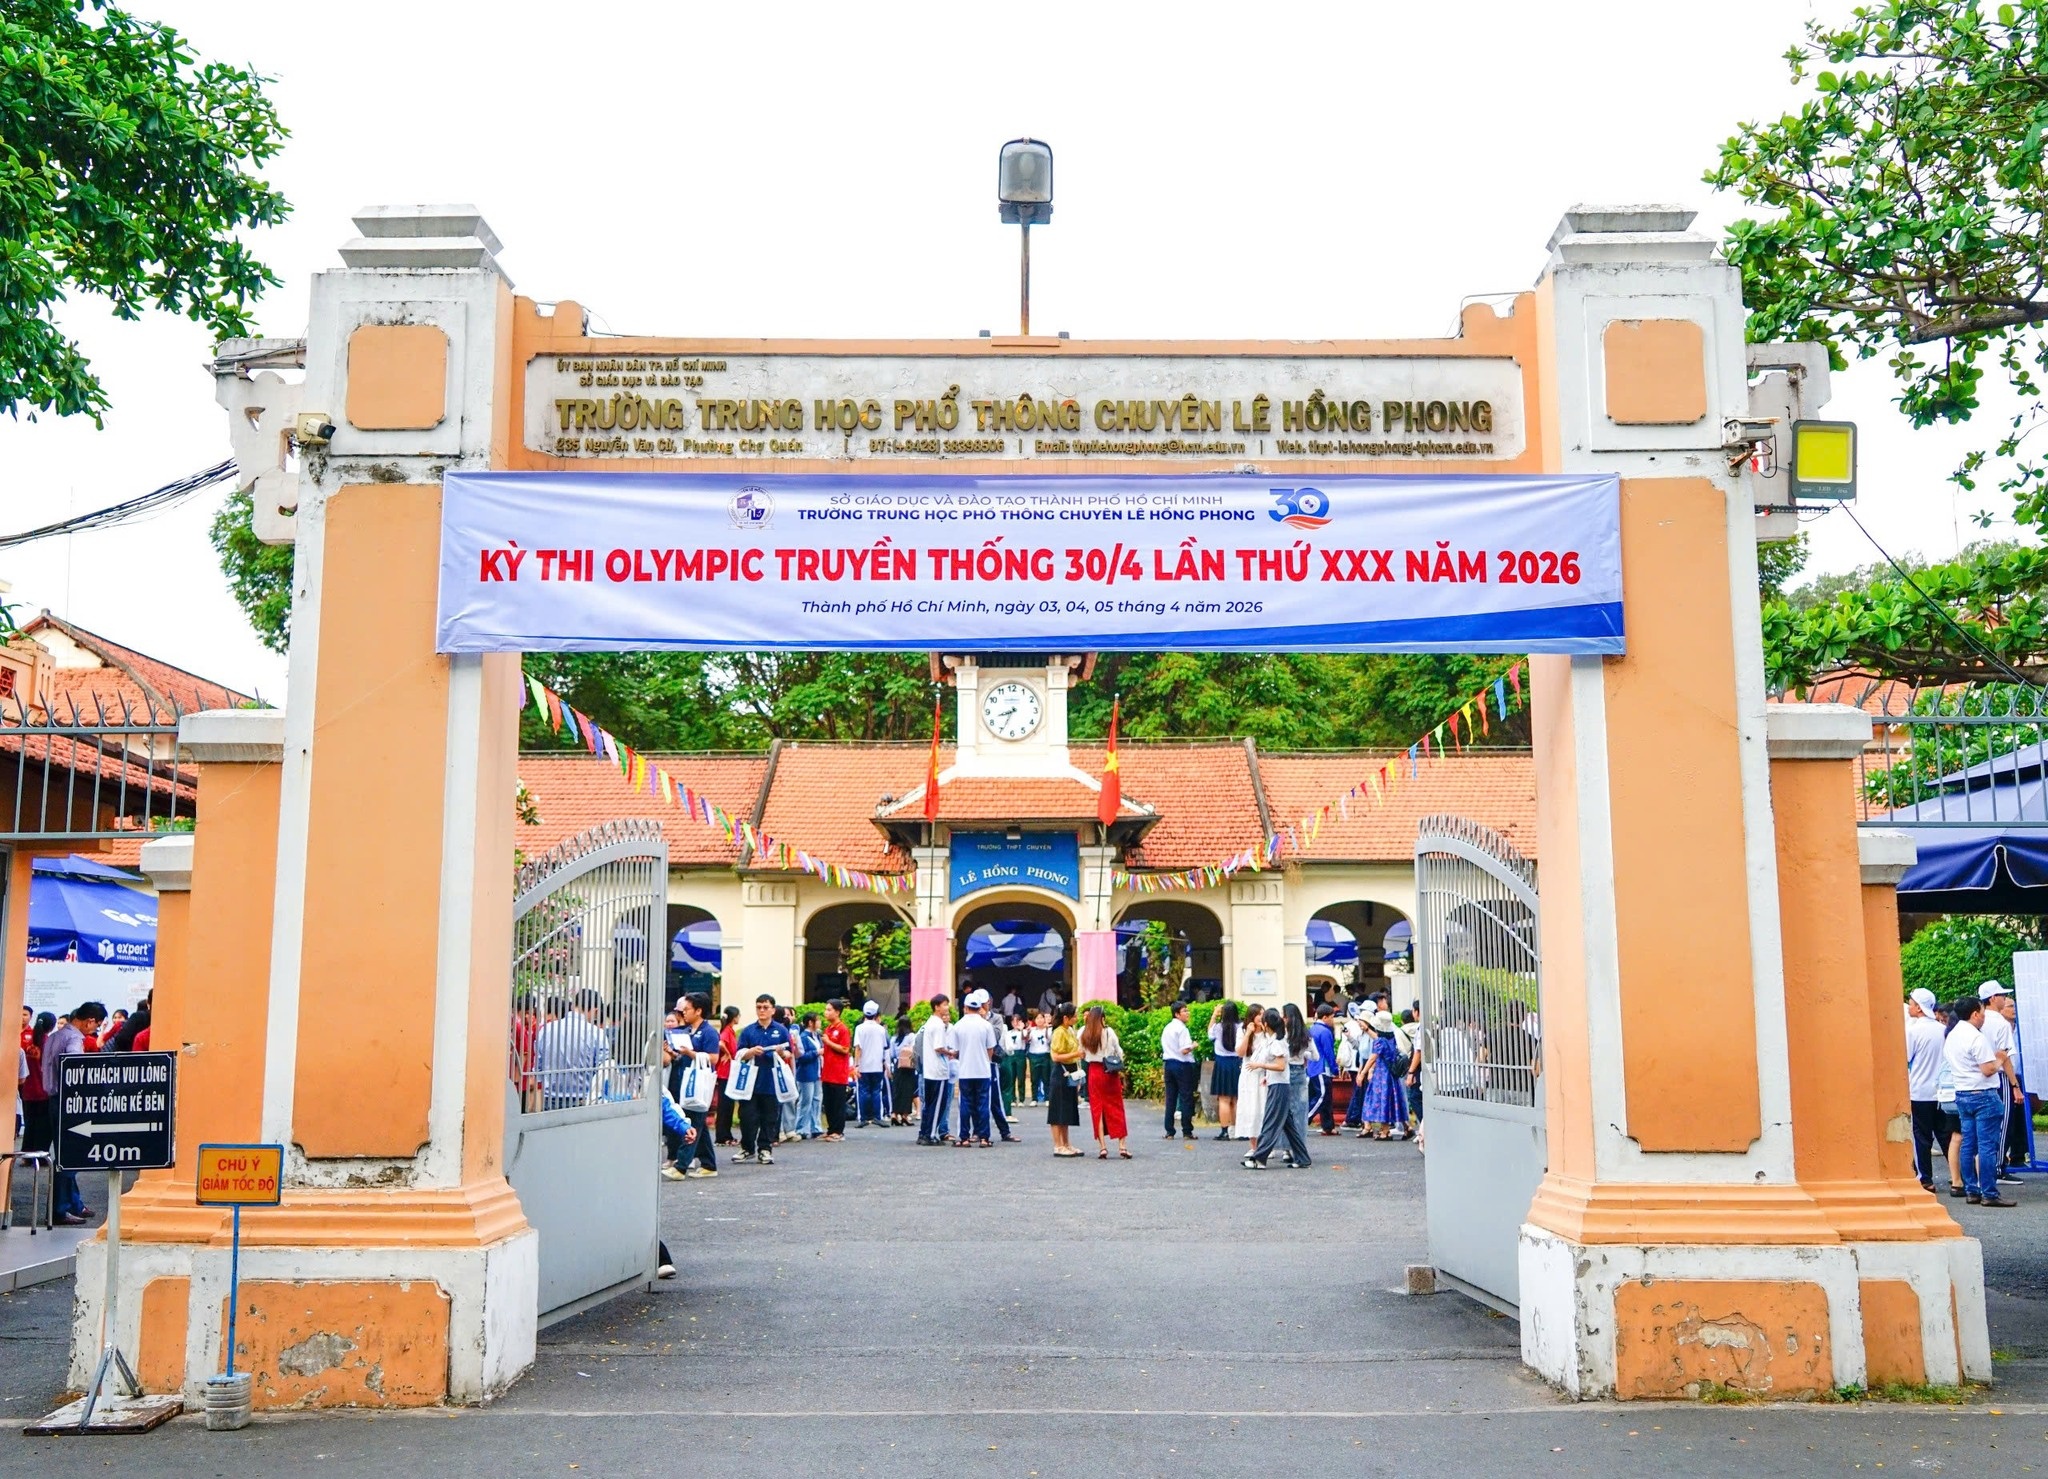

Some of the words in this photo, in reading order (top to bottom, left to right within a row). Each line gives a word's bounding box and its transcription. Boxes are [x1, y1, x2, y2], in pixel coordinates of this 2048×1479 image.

[573, 361, 593, 372] BAN
[596, 359, 623, 372] NHÂN
[626, 359, 646, 372] DÂN
[648, 361, 663, 372] TP.
[682, 358, 699, 372] CHÍ
[701, 361, 727, 372] MINH
[580, 373, 594, 386] SỞ
[596, 374, 619, 386] GIÁO
[621, 376, 642, 388] DỤC
[645, 374, 657, 386] VÀ
[660, 374, 680, 386] ĐÀO
[684, 376, 703, 387] TẠO
[555, 391, 684, 430] TRƯỜNG
[697, 399, 803, 430] TRUNG
[814, 399, 882, 437] HỌC
[894, 384, 960, 430] PHỔ
[972, 392, 1080, 431] THÔNG
[1094, 392, 1222, 431] CHUYÊN
[1233, 393, 1271, 432] LÊ
[1282, 389, 1371, 432] HỒNG
[1382, 400, 1493, 432] PHONG
[556, 438, 579, 451] 235
[584, 436, 629, 453] Nguyễn
[633, 438, 653, 451] Văn
[683, 439, 733, 454] Phường
[739, 439, 765, 454] Chợ
[769, 438, 803, 452] Quán
[1035, 440, 1070, 453] Email:
[830, 493, 851, 506] SỞ
[855, 494, 893, 506] GIÁO
[897, 496, 929, 507] DỤC
[933, 494, 954, 506] VÀ
[958, 494, 992, 506] ĐÀO
[995, 496, 1026, 507] TẠO
[1030, 494, 1083, 506] THÀNH
[1088, 493, 1121, 506] PHỐ
[1152, 494, 1178, 506] CHÍ
[1182, 496, 1223, 506] MINH
[798, 507, 863, 520] TRƯỜNG
[867, 509, 920, 520] TRUNG
[925, 510, 958, 522] HỌC
[963, 506, 996, 520] PHỔ
[1000, 507, 1055, 520] THÔNG
[1059, 507, 1123, 520] CHUYÊN
[1127, 507, 1145, 520] LÊ
[1150, 507, 1195, 520] HỒNG
[1200, 510, 1255, 521] PHONG
[479, 540, 526, 582] KỲ
[536, 549, 594, 582] THI
[605, 549, 765, 582] OLYMPIC
[774, 536, 916, 581] TRUYỀN
[928, 536, 1054, 581] THỐNG
[1064, 543, 1144, 585] 30/4
[1154, 536, 1225, 581] LẦN
[1235, 540, 1312, 582] THỨ
[1320, 550, 1395, 582] XXX
[1406, 541, 1487, 584] NĂM
[1497, 551, 1581, 584] 2026
[802, 601, 851, 613] Thành
[855, 600, 887, 615] phố
[891, 600, 913, 613] Hồ
[917, 600, 944, 613] Chí
[947, 600, 990, 614] Minh,
[994, 600, 1036, 615] ngày
[1039, 601, 1061, 614] 03,
[1065, 601, 1089, 614] 04,
[1094, 601, 1114, 613] 05
[1118, 600, 1166, 615] tháng
[1170, 601, 1181, 613] 4
[1185, 600, 1221, 613] năm
[1225, 601, 1263, 613] 2026
[1008, 684, 1017, 692] 12
[989, 696, 998, 704] 10
[990, 719, 995, 727] 8
[1029, 718, 1035, 726] 4
[999, 726, 1004, 734] 7
[1010, 729, 1015, 737] 6
[1021, 726, 1026, 734] 5
[959, 870, 978, 886] LÊ
[982, 863, 1018, 879] HỒNG
[1026, 866, 1070, 886] PHONG
[116, 943, 148, 956] expert
[65, 1064, 85, 1087] QUÝ
[87, 1064, 120, 1084] KHÁCH
[122, 1066, 138, 1083] VUI
[141, 1062, 167, 1083] LÒNG
[66, 1091, 83, 1114] GỬI
[85, 1097, 98, 1113] XE
[100, 1089, 127, 1113] CỔNG
[130, 1090, 143, 1112] KẾ
[145, 1091, 165, 1111] BÊN
[87, 1144, 141, 1162] 40m
[218, 1156, 247, 1171] CHÚ
[252, 1155, 260, 1171] Ý
[202, 1173, 229, 1190] GIẢM
[232, 1173, 255, 1190] TỐC
[258, 1175, 275, 1193] ĐỘ
